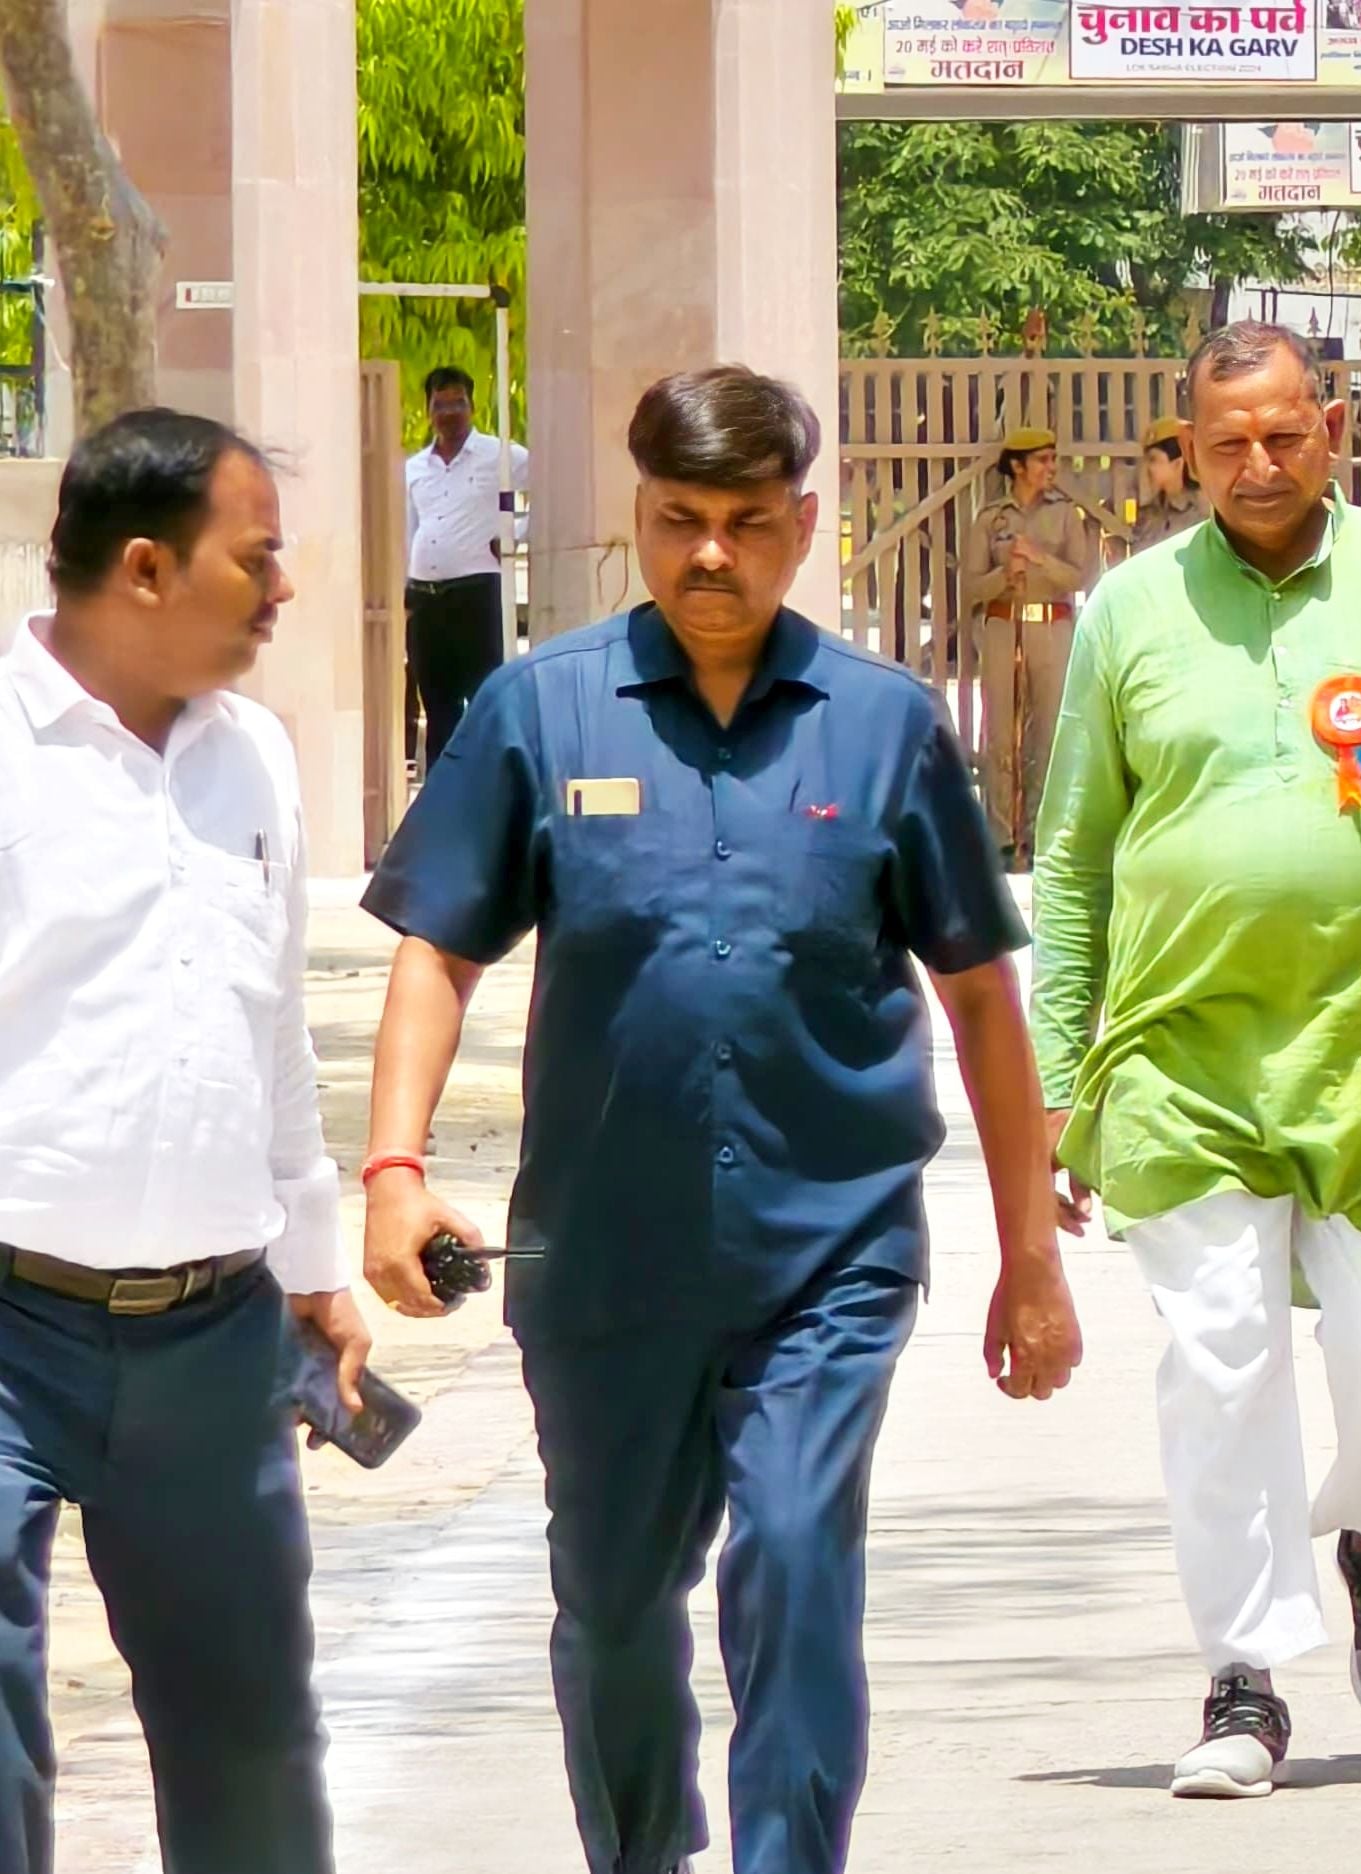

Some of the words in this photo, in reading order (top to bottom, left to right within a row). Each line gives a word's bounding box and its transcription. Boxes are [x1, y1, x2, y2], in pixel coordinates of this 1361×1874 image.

[1077, 6, 1181, 45] चुनाव
[1188, 7, 1242, 33] का
[1250, 0, 1306, 34] पर्व
[896, 40, 912, 54] 20
[917, 35, 936, 56] मई
[941, 35, 957, 53] को
[1120, 37, 1183, 56] DESH
[1189, 38, 1224, 56] KA
[1229, 38, 1298, 57] GARV
[930, 59, 1024, 80] मतदान
[1258, 185, 1320, 201] मतदान
